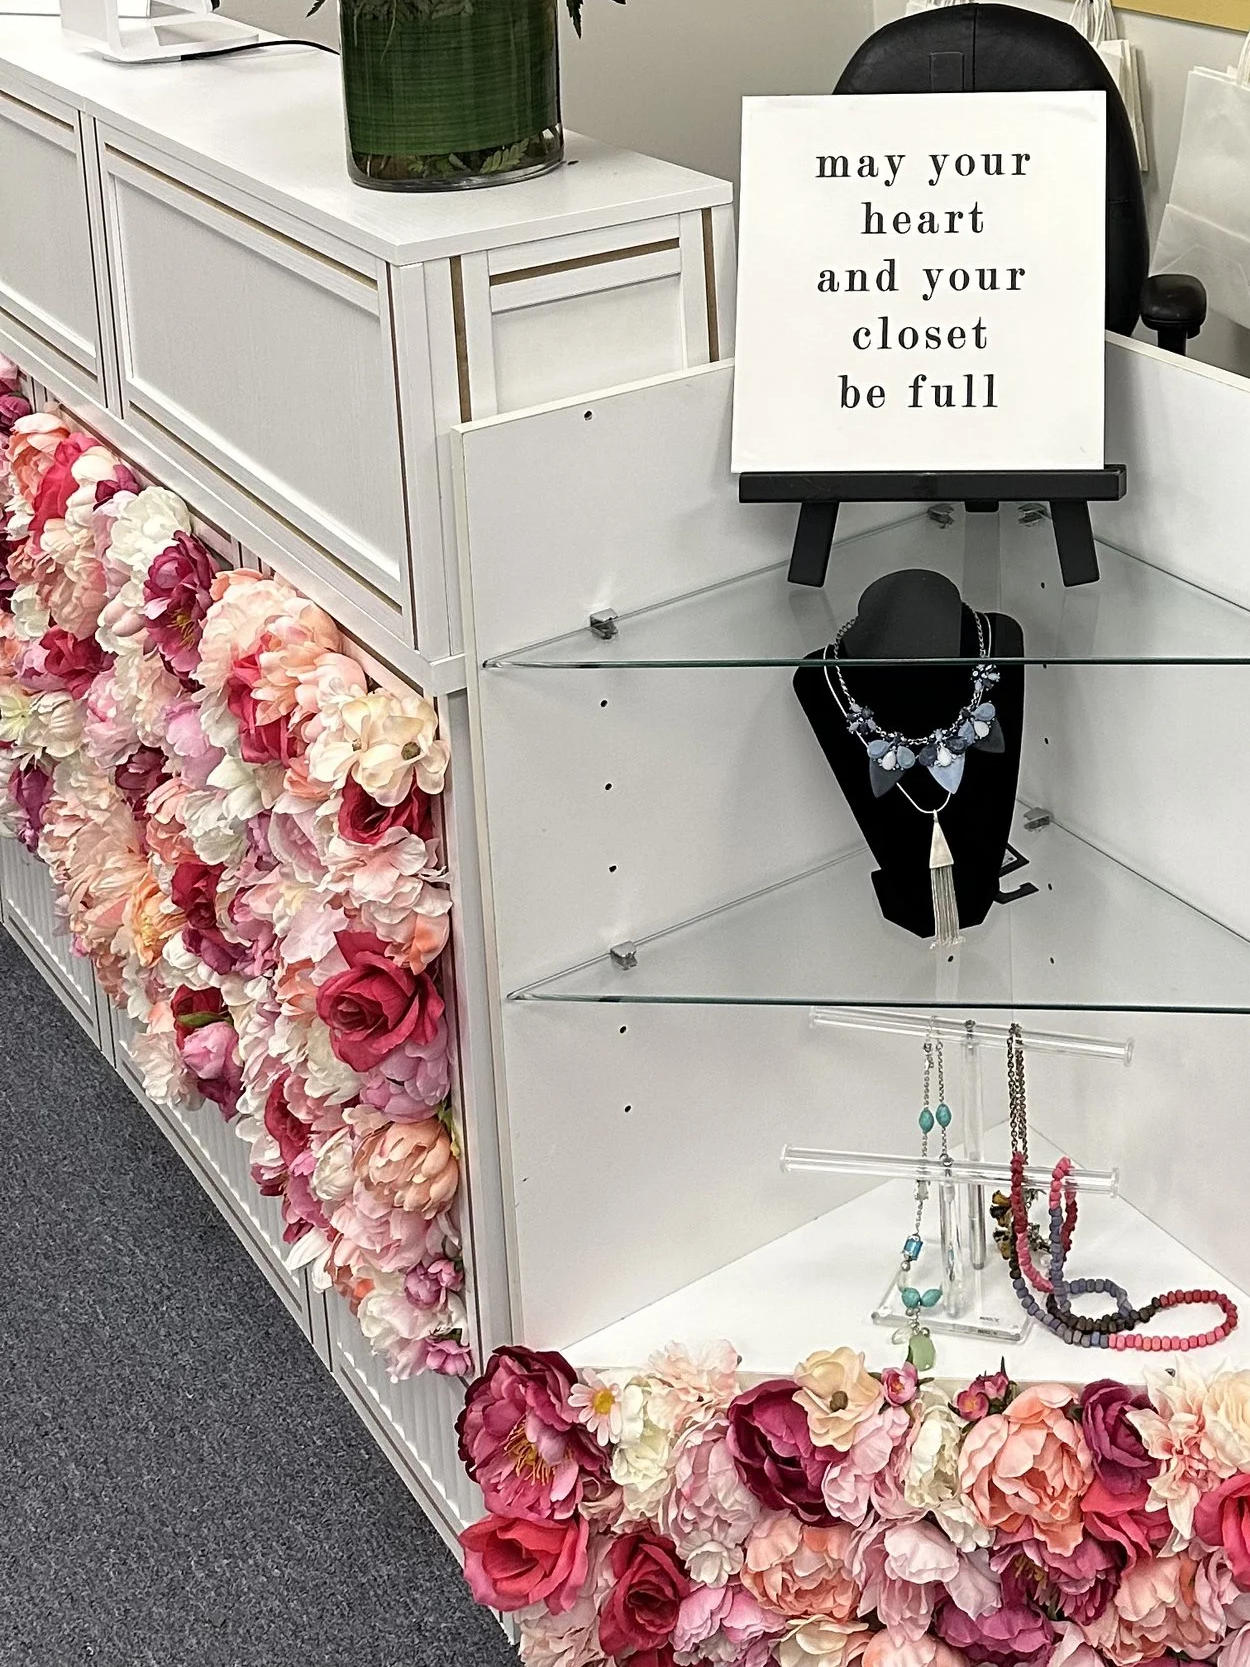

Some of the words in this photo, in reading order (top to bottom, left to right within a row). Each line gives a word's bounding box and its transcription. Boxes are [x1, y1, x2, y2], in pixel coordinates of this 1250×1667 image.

[815, 154, 906, 187] may
[928, 153, 1031, 186] your
[861, 201, 984, 235] heart
[817, 258, 899, 293] and
[922, 267, 1026, 302] your
[852, 315, 988, 350] closet
[838, 374, 886, 409] be
[907, 373, 998, 409] full
